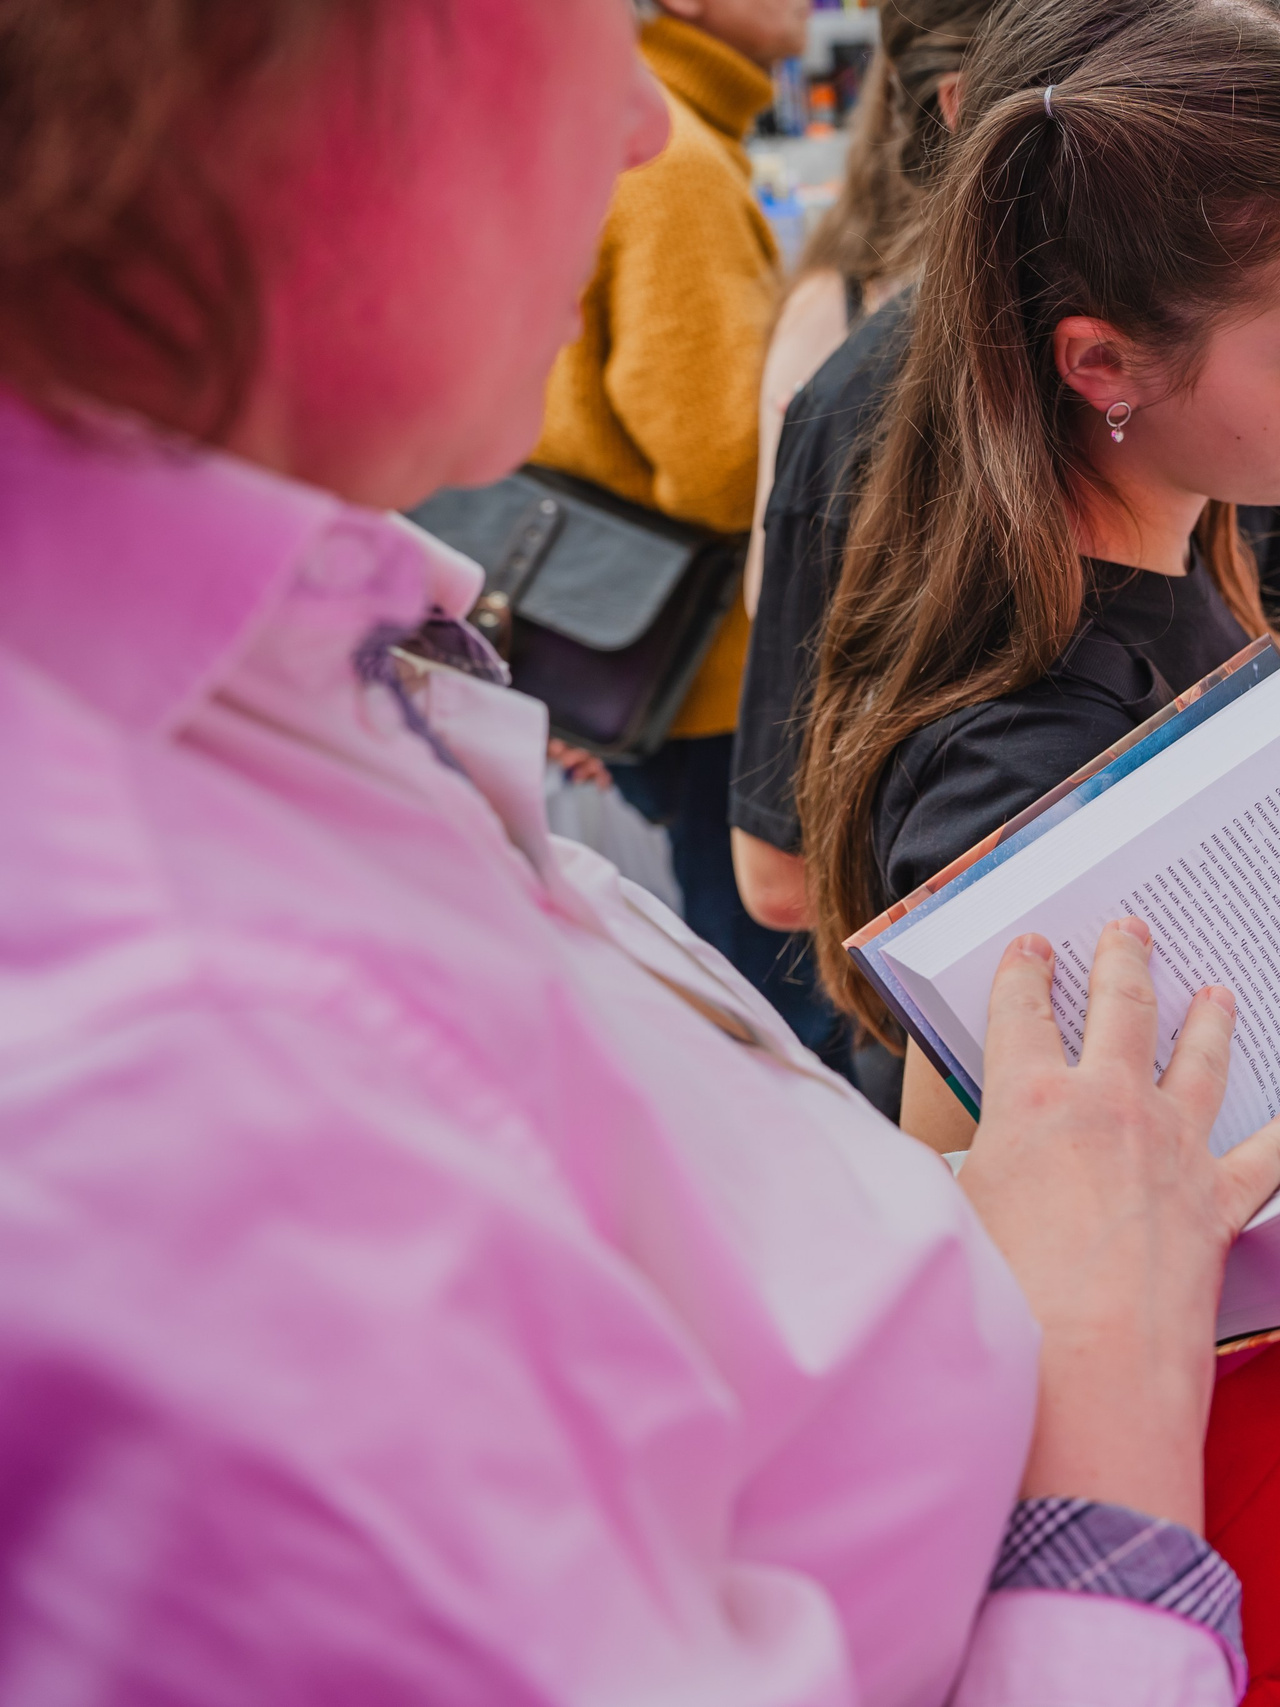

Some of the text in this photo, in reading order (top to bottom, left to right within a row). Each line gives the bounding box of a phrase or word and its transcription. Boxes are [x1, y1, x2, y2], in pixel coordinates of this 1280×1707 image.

[1232, 818, 1253, 844] стями
[1243, 809, 1256, 828] тях,
[1263, 837, 1280, 859] сами
[1253, 801, 1280, 836] болезни
[1264, 794, 1280, 816] того,
[1199, 841, 1219, 864] когда
[1228, 879, 1251, 908] видела
[1249, 907, 1266, 929] одни
[1210, 833, 1233, 861] видела
[1230, 860, 1248, 881] одни
[1245, 880, 1270, 916] горести,
[1221, 825, 1256, 869] незаметны
[1253, 868, 1272, 895] были,
[1165, 865, 1193, 899] можные
[1189, 898, 1215, 931] усилия,
[1216, 929, 1232, 950] чтоб
[1227, 949, 1252, 982] убедить
[1250, 982, 1265, 1005] себя,
[1177, 857, 1202, 889] знавать
[1201, 888, 1214, 904] эти
[1211, 903, 1239, 939] радости.
[1240, 938, 1257, 968] Часто,
[1256, 967, 1274, 992] глядя
[1198, 860, 1220, 893] Теперь,
[1225, 899, 1260, 944] уединении
[1068, 949, 1089, 975] конце
[1131, 890, 1266, 1094] все разных родах, редко бывают,
[1154, 873, 1168, 892] она,
[1167, 890, 1182, 907] как
[1179, 905, 1195, 928] мать,
[1234, 982, 1253, 1009] своим
[1249, 1008, 1269, 1036] детям;
[1160, 903, 1271, 1072] говорить себе, что релестные дети,
[1170, 964, 1197, 997] гордила
